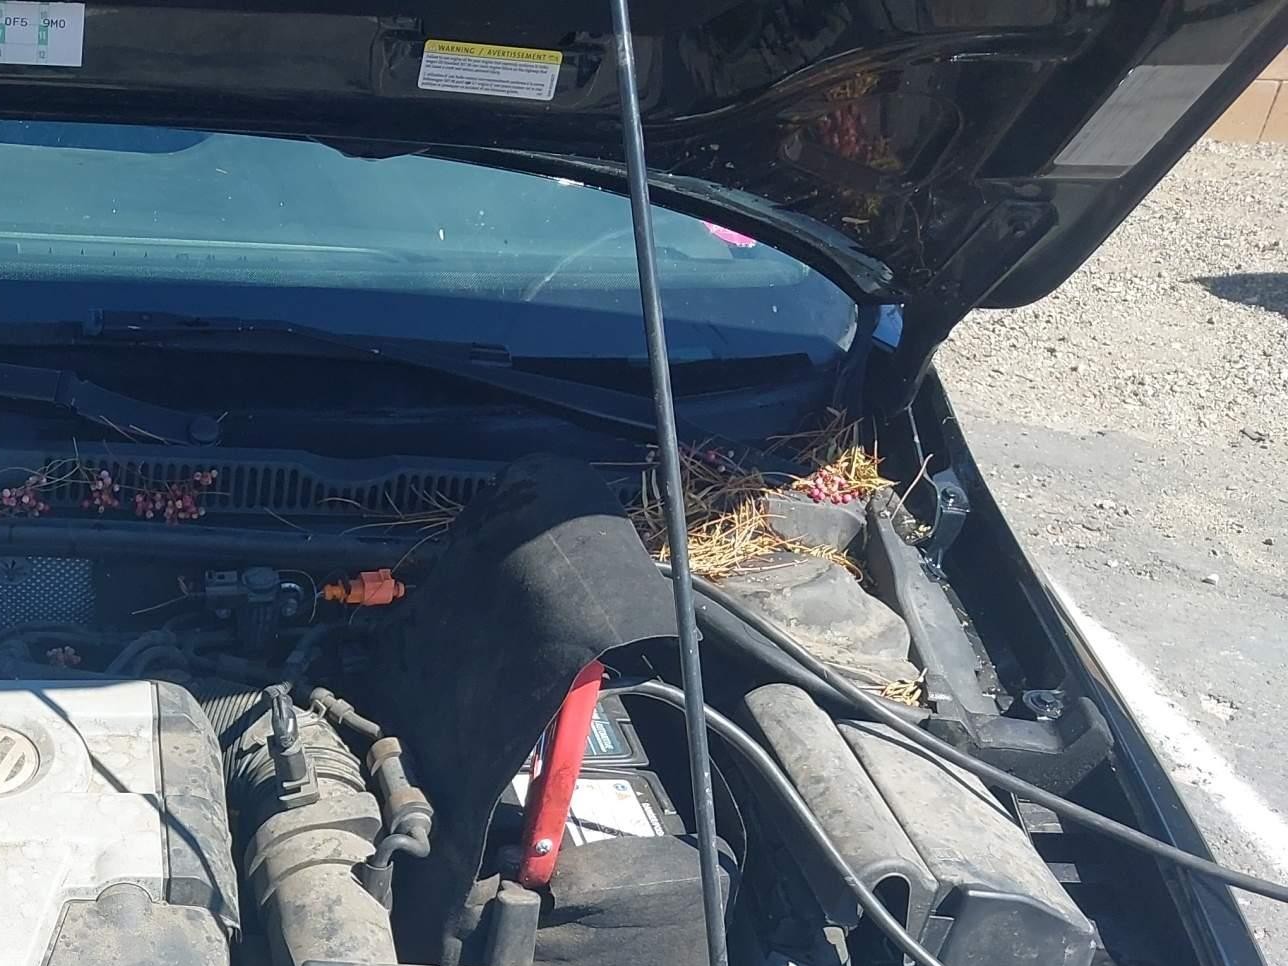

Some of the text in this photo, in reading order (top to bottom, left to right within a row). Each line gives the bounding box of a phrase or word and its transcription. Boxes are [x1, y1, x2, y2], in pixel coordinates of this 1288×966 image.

[438, 44, 547, 61] WARNING / AVERTISSEMENT
